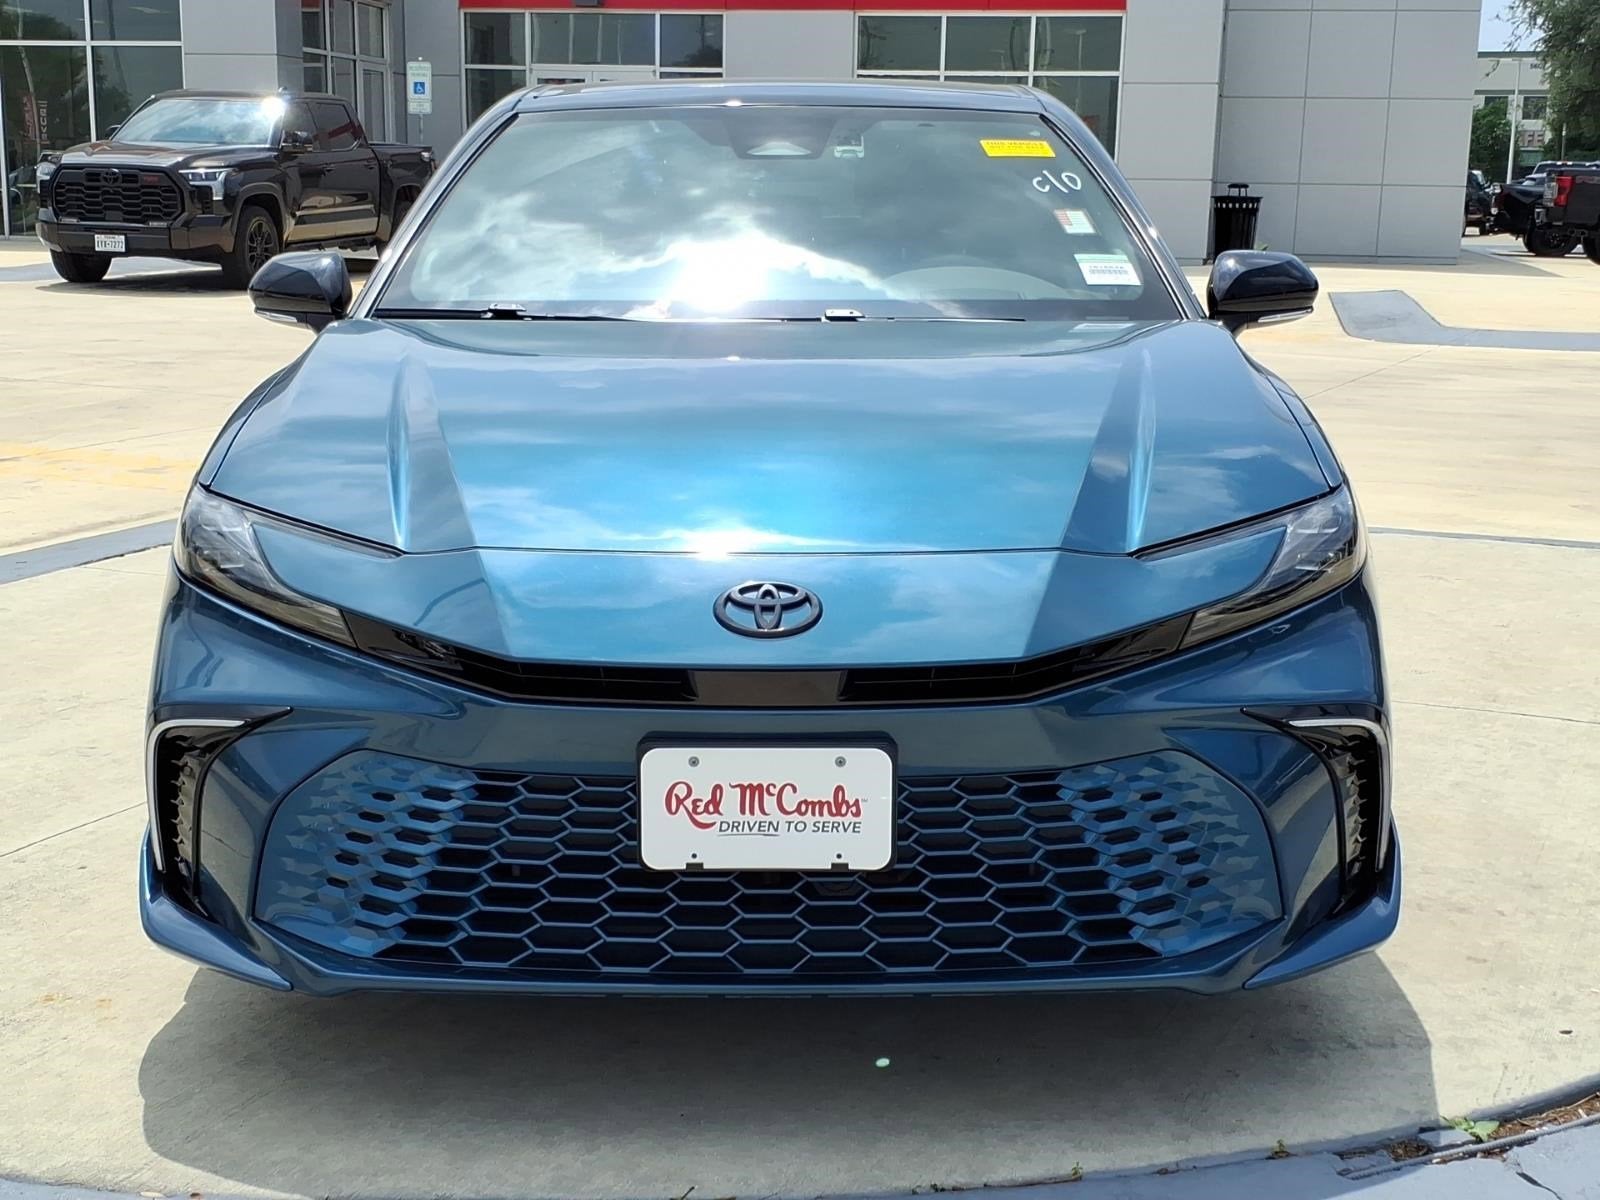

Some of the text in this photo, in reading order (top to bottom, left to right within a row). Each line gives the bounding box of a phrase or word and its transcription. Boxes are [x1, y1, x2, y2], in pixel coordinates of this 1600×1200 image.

[665, 781, 861, 829] Red McCombs
[718, 820, 861, 834] DRIVEN TO SERVE
